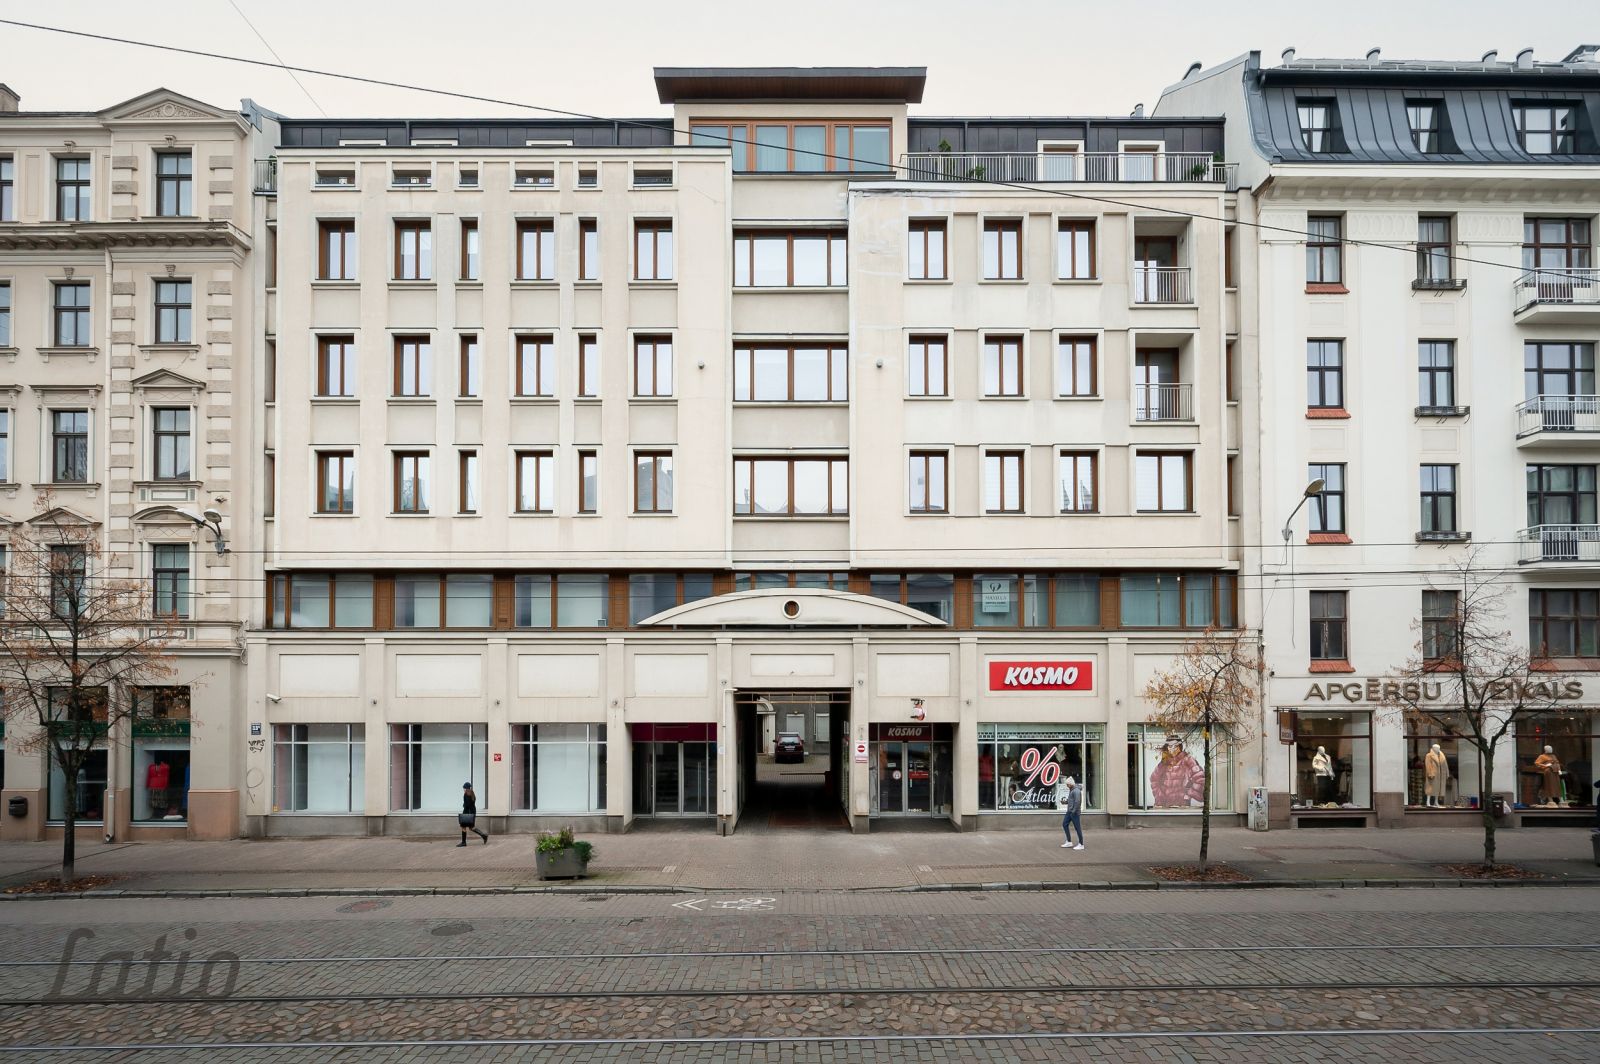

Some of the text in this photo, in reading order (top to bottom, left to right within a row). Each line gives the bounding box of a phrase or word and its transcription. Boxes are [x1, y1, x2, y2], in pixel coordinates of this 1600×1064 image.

[1004, 666, 1079, 686] KOSMO
[1304, 678, 1584, 703] APGĒRBU VEIKALS
[887, 727, 922, 737] KOSMO
